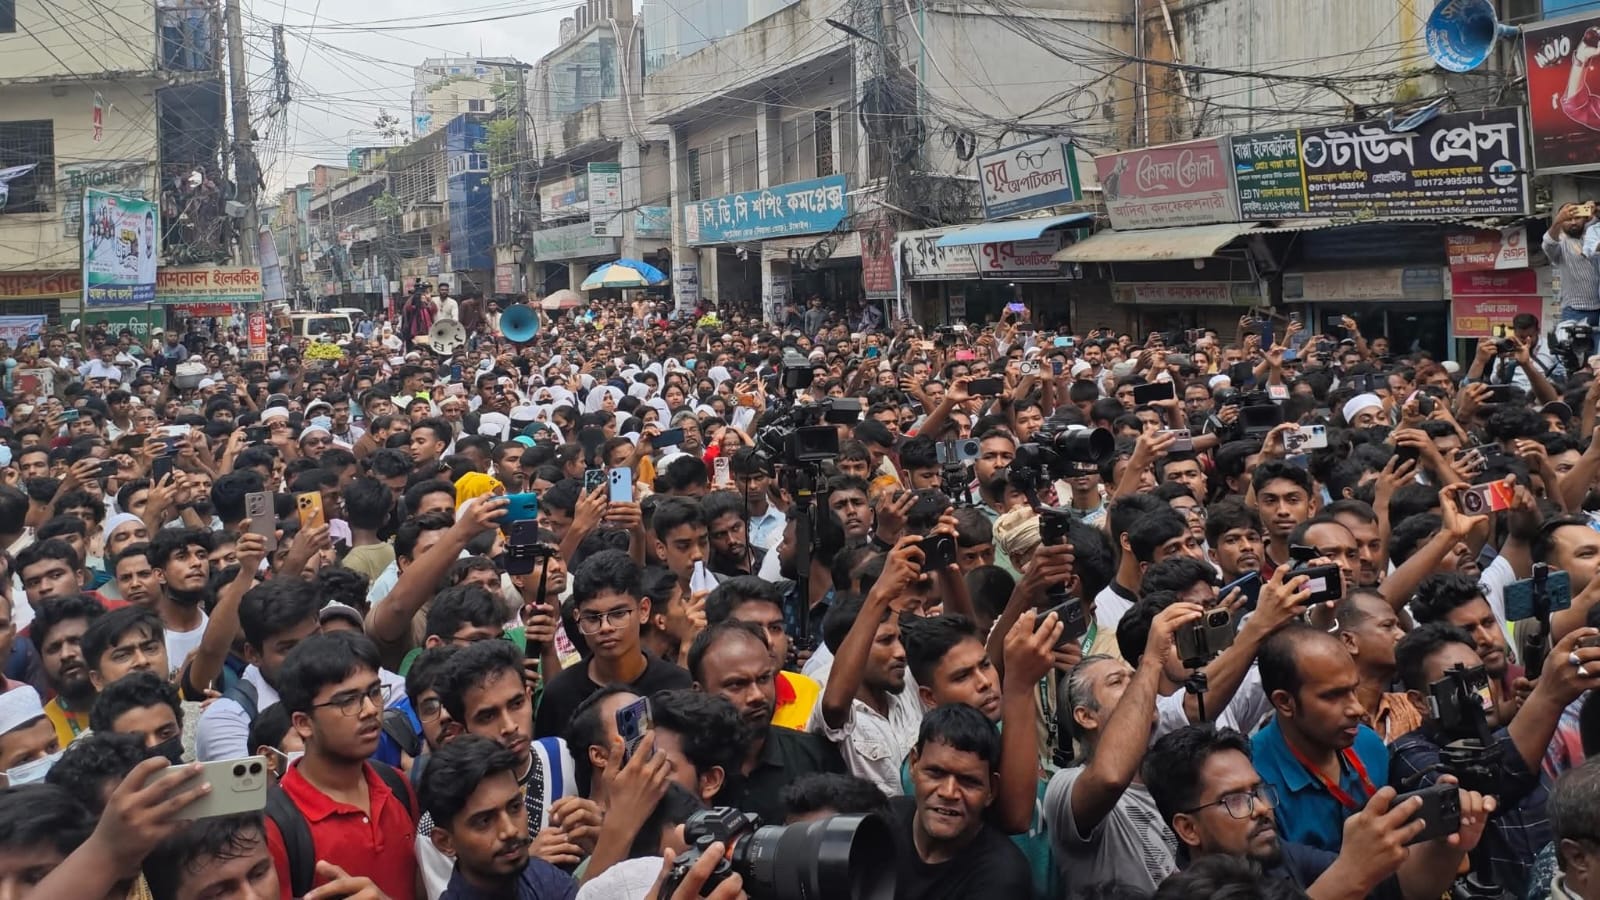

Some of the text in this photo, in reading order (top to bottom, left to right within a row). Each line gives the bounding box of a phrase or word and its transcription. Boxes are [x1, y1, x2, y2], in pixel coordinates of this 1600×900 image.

[1325, 127, 1420, 169] টাউন
[1430, 122, 1516, 163] প্রেস
[752, 190, 784, 220] শপিং
[1241, 189, 1252, 199] LED
[1252, 188, 1260, 198] TV
